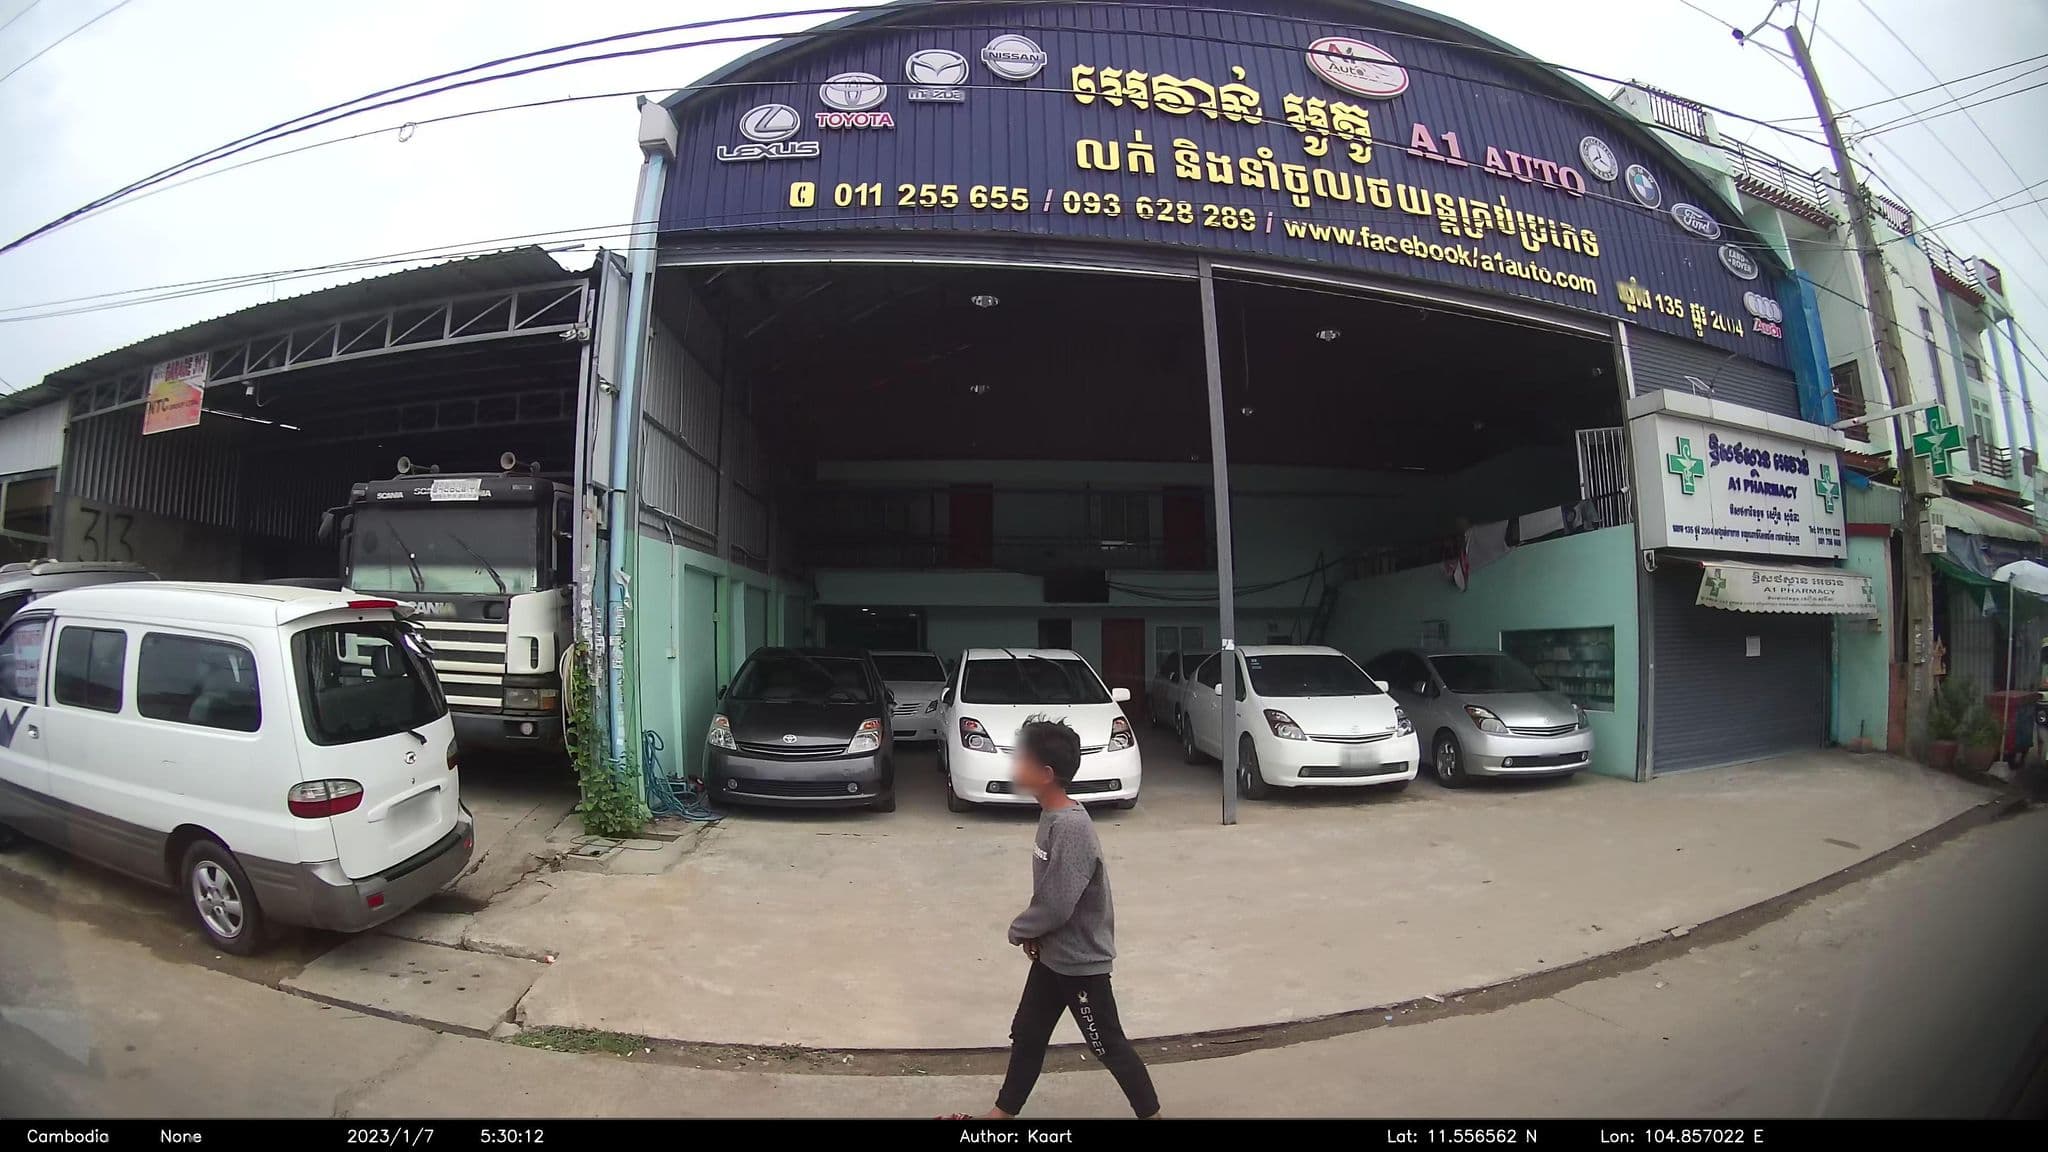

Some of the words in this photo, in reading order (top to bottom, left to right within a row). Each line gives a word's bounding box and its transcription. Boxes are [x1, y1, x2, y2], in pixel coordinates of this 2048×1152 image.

[988, 50, 1041, 63] NISSAN
[815, 111, 895, 129] TOYOTA
[717, 140, 820, 163] LEXUS
[1075, 129, 1156, 175] លក់
[1407, 121, 1469, 167] A1
[1484, 145, 1586, 197] AUTO
[833, 182, 883, 207] 011
[897, 183, 960, 209] 255
[969, 184, 1030, 212] 655
[1062, 190, 1122, 218] 093
[1135, 195, 1195, 225] 628
[1202, 203, 1257, 231] 289
[1684, 208, 1711, 234] Ford
[1655, 293, 1685, 319] 135
[376, 491, 404, 500] SCANIA
[1728, 476, 1741, 491] A1
[1743, 478, 1798, 499] PHARMACY
[1780, 587, 1836, 595] PHARMACY
[1080, 1006, 1106, 1056] SPYDER
